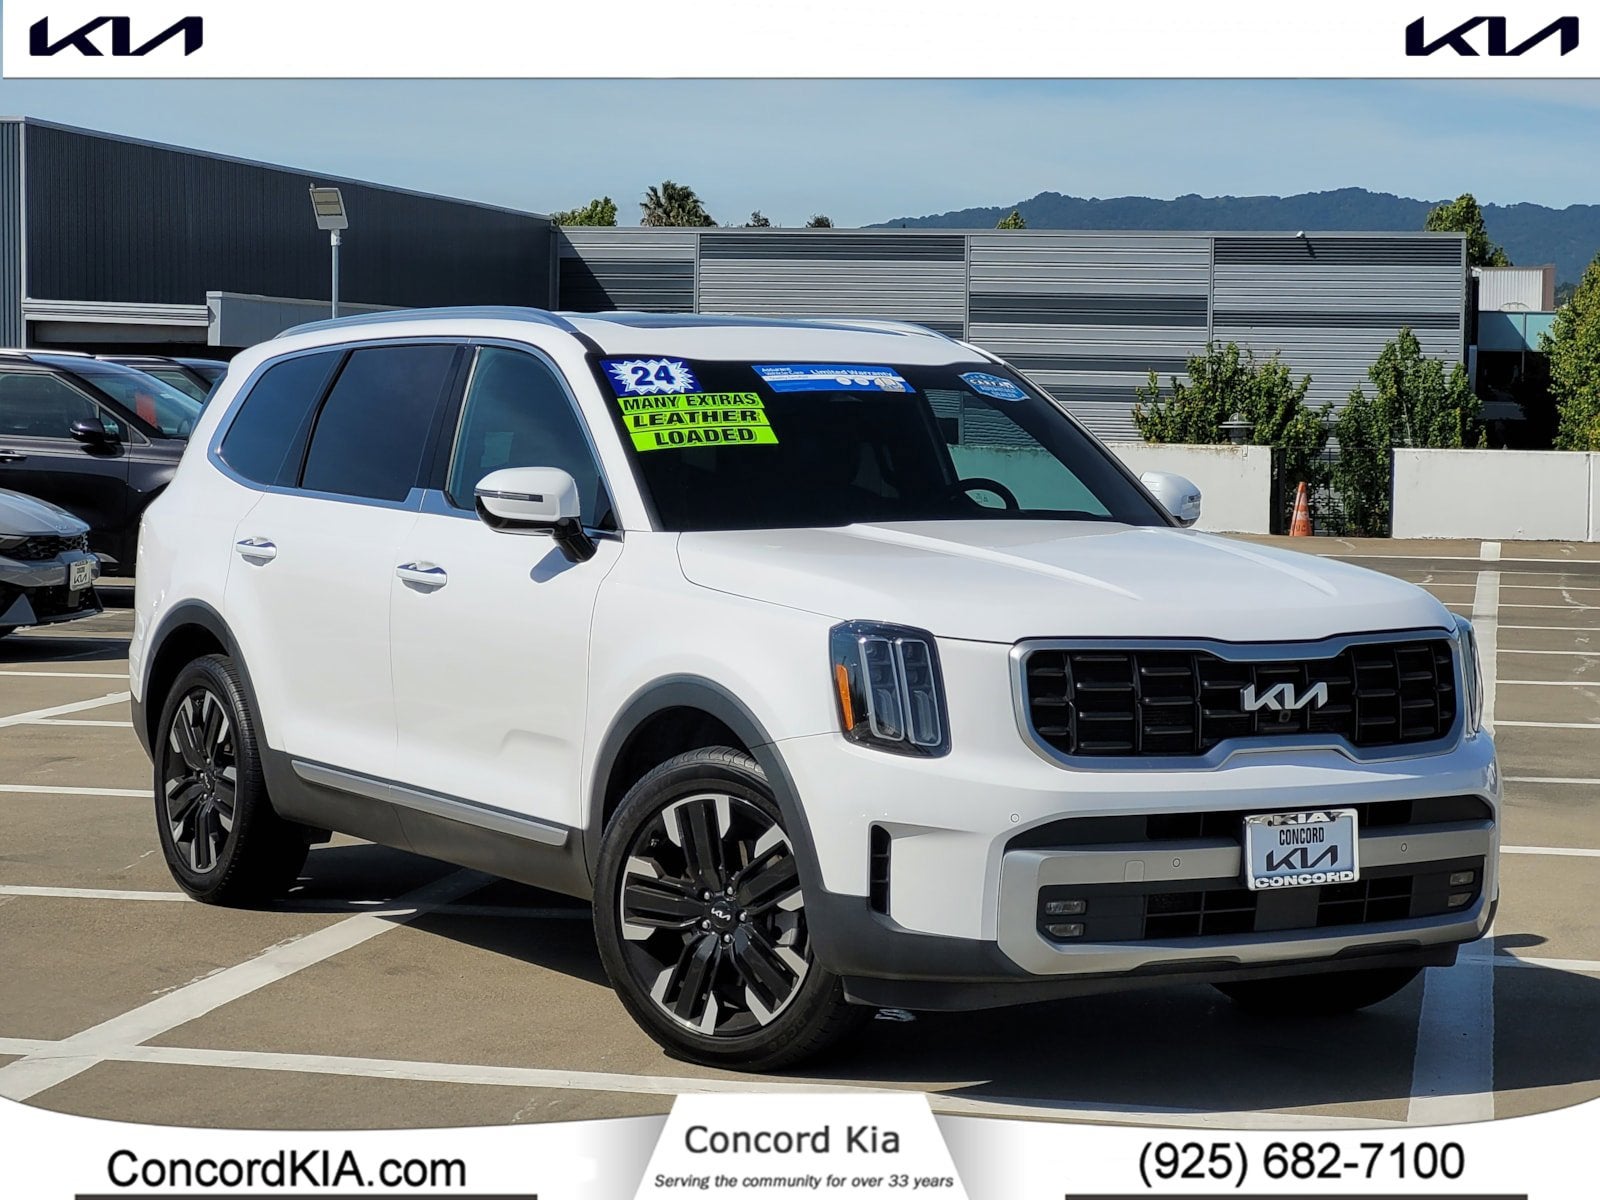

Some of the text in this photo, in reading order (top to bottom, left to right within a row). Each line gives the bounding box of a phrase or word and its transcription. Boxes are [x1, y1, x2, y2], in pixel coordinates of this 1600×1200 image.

[631, 365, 676, 386] 24
[623, 393, 758, 411] MANY EXTRAS
[633, 409, 761, 428] LEATHER
[654, 428, 757, 446] LOADED
[1241, 681, 1328, 711] KIA
[1280, 827, 1325, 846] CONCORD
[1265, 845, 1339, 872] KIA
[1255, 870, 1355, 888] CONCORD
